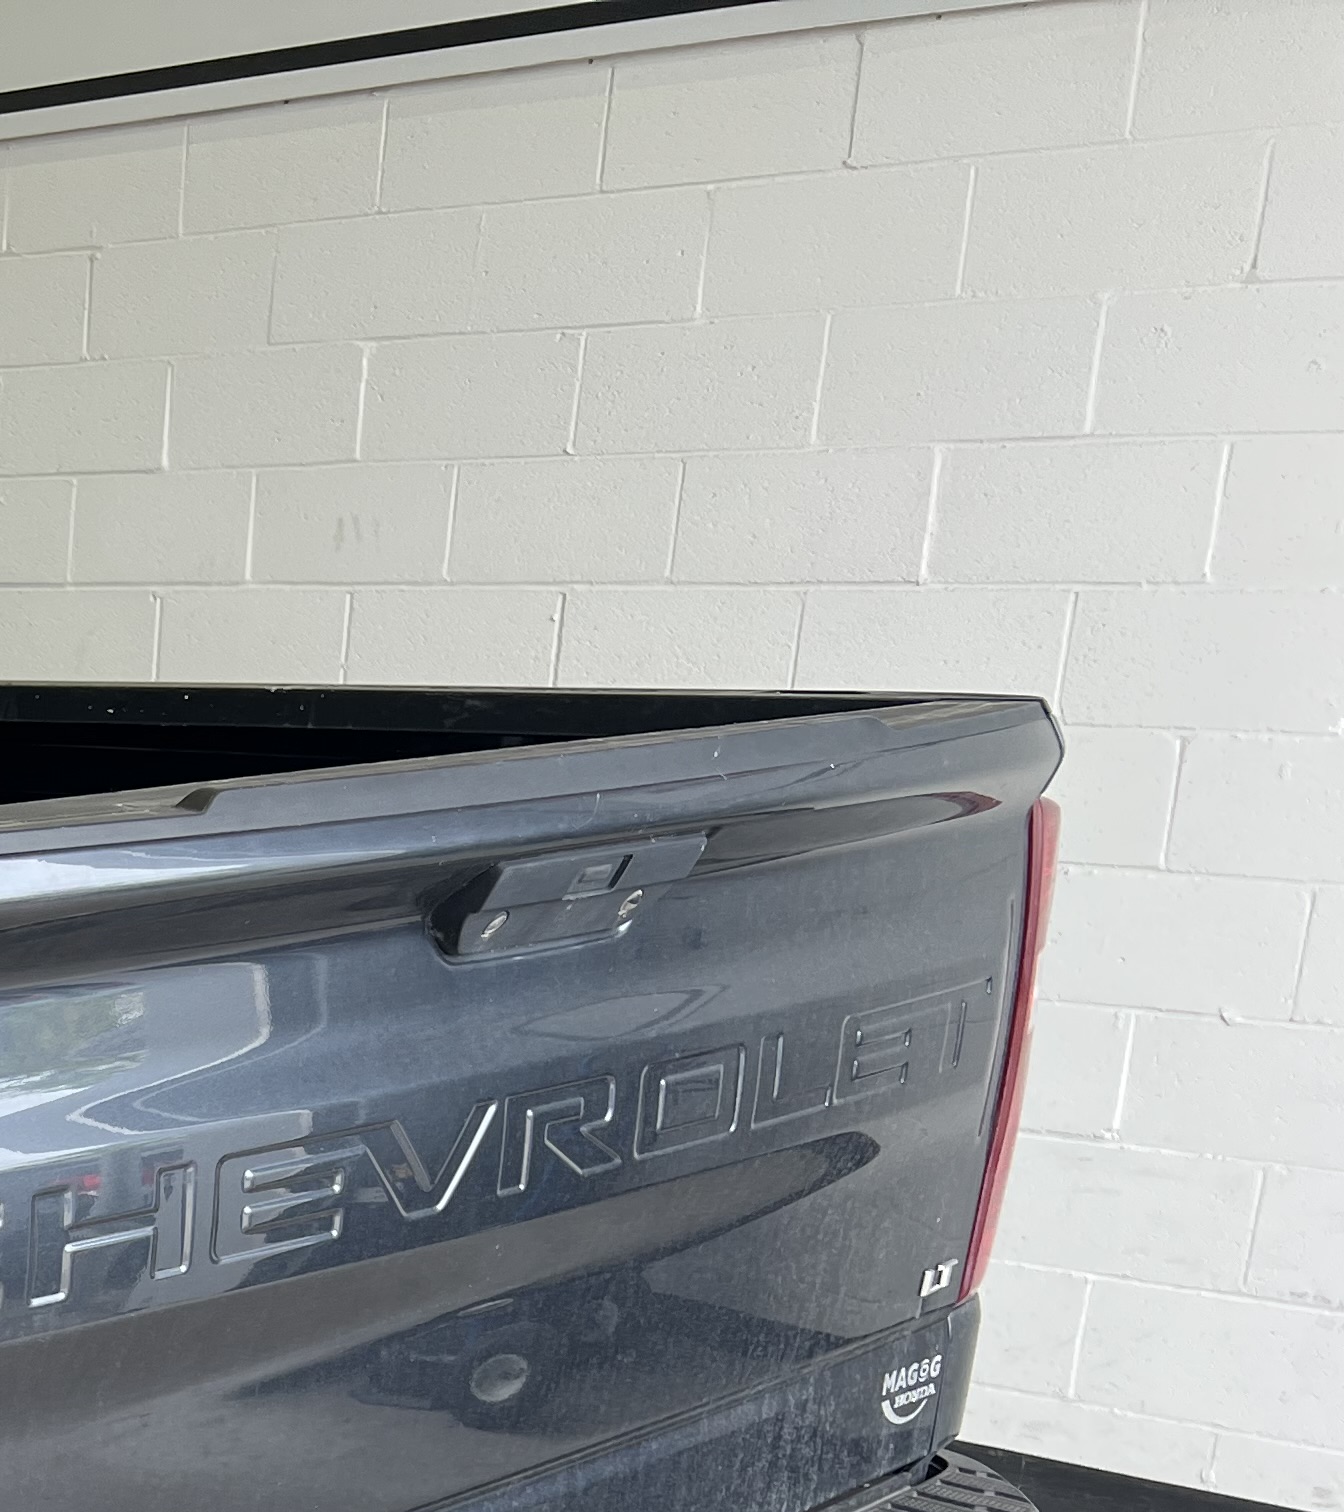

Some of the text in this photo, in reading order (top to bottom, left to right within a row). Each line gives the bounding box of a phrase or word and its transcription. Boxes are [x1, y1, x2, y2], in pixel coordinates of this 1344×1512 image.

[919, 1258, 960, 1298] LT
[881, 1354, 943, 1397] MAGOG
[893, 1382, 937, 1410] HONDA
